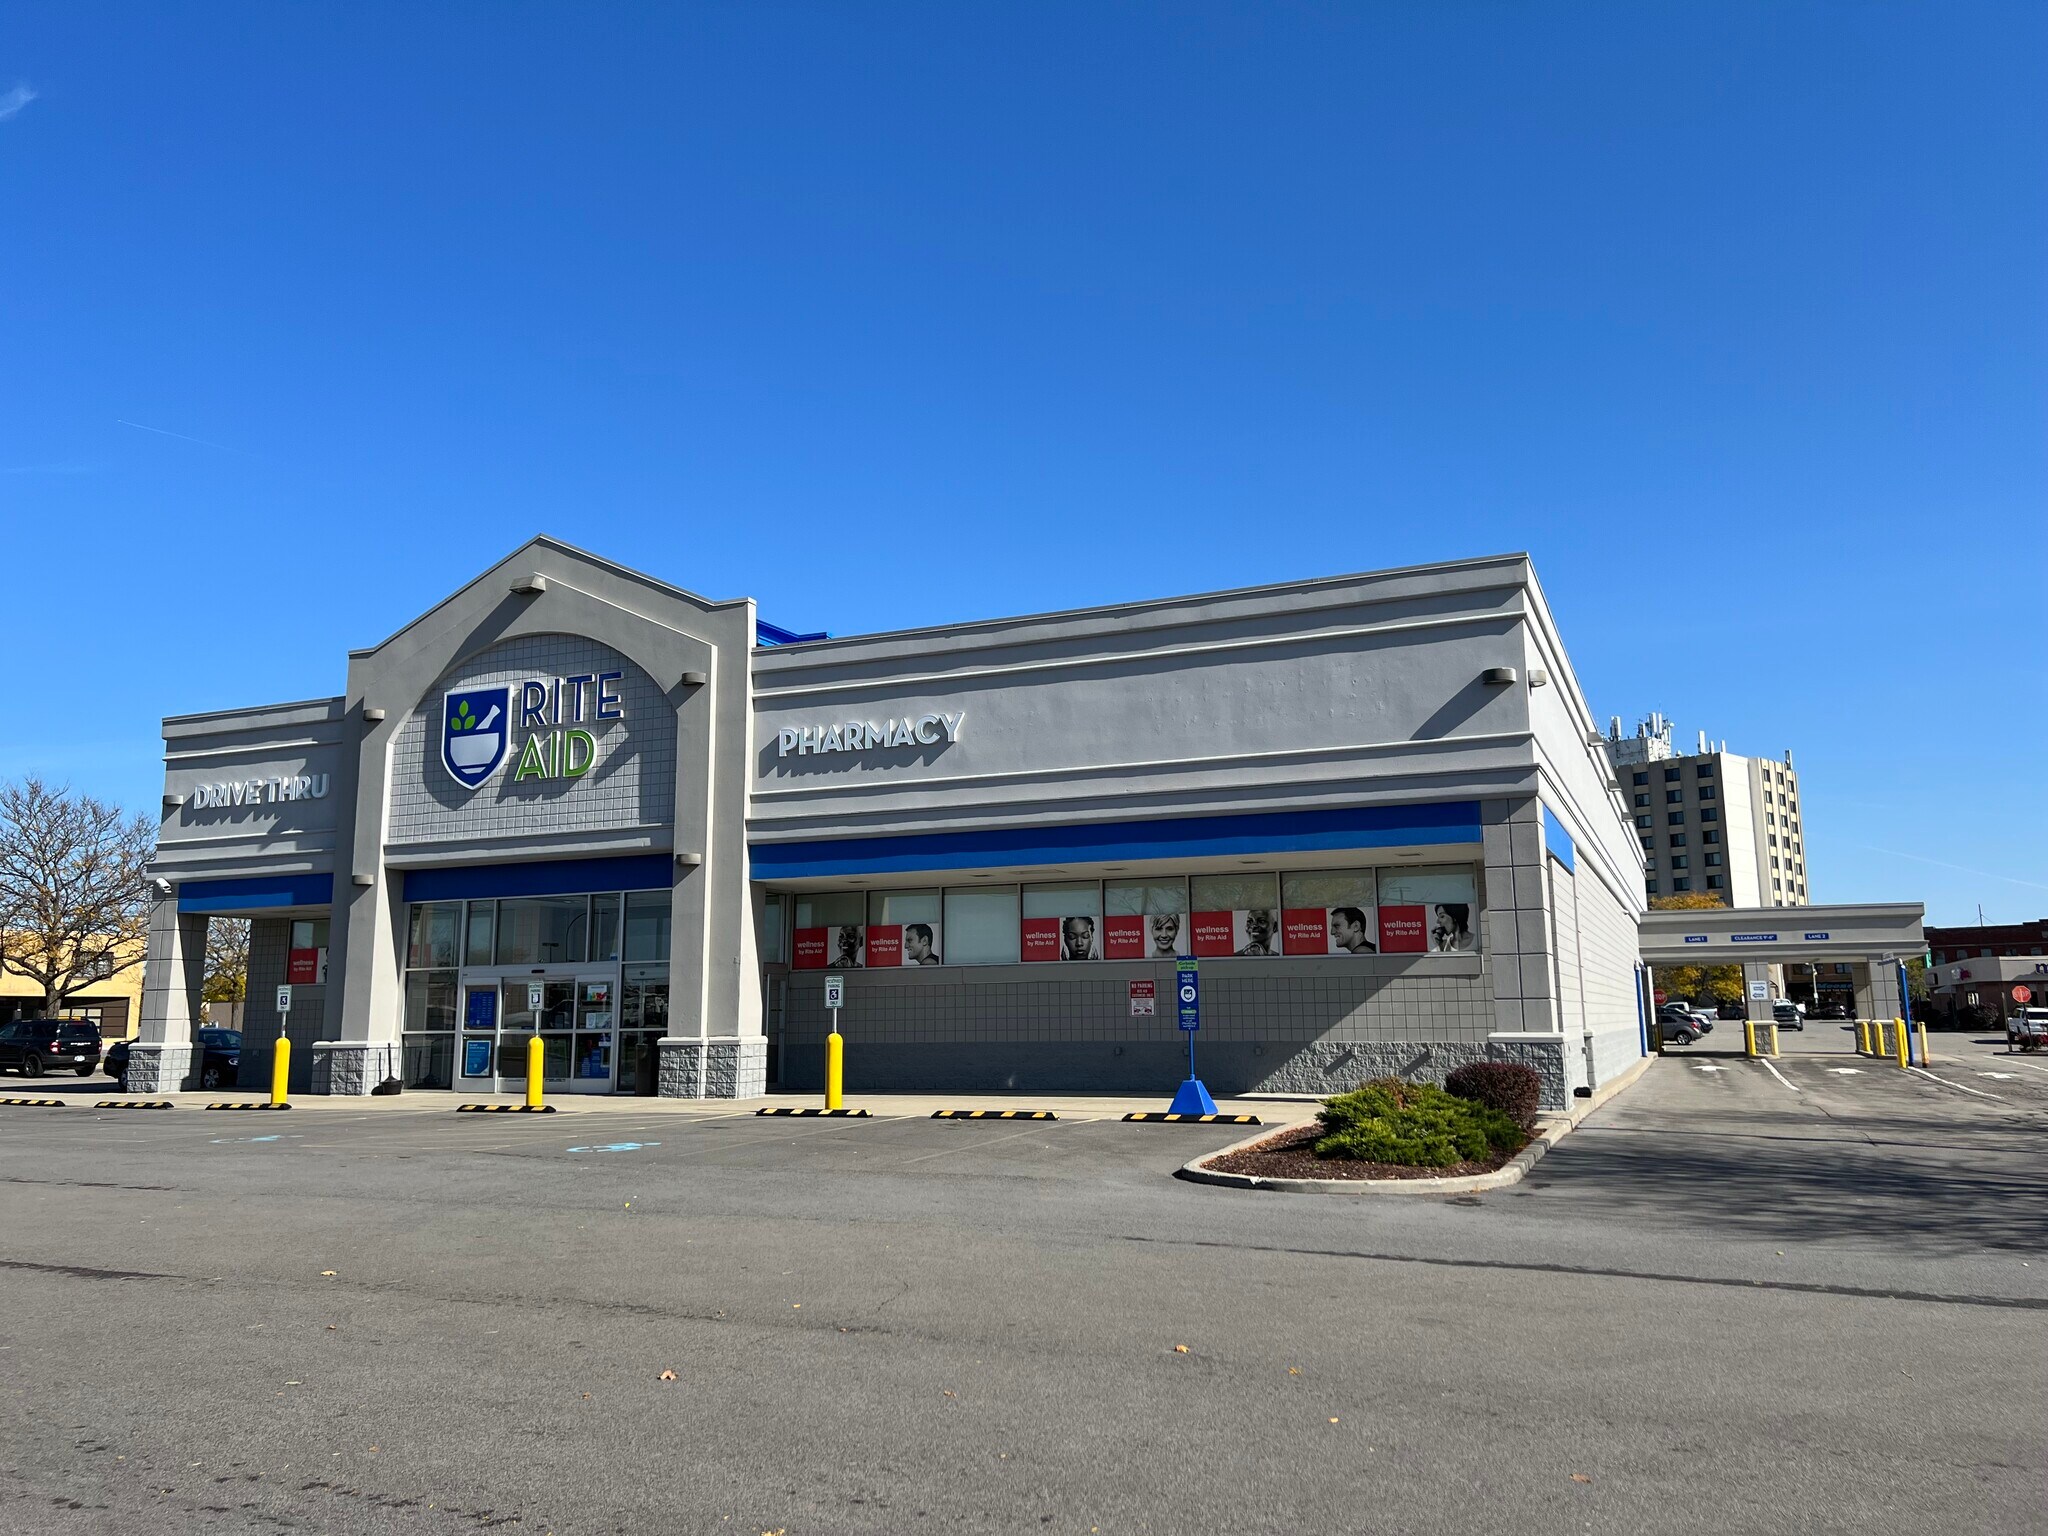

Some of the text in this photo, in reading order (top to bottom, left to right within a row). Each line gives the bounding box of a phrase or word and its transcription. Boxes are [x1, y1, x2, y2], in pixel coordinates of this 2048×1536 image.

[520, 671, 624, 727] RITE
[779, 712, 965, 757] PHARMACY
[514, 729, 597, 781] AID
[194, 773, 330, 809] DRIVE THRU
[1287, 923, 1323, 931] wellness
[1384, 920, 1422, 928] wellness
[1108, 929, 1140, 937] wellness
[870, 938, 899, 946] wellness
[2014, 990, 2030, 998] STOP
